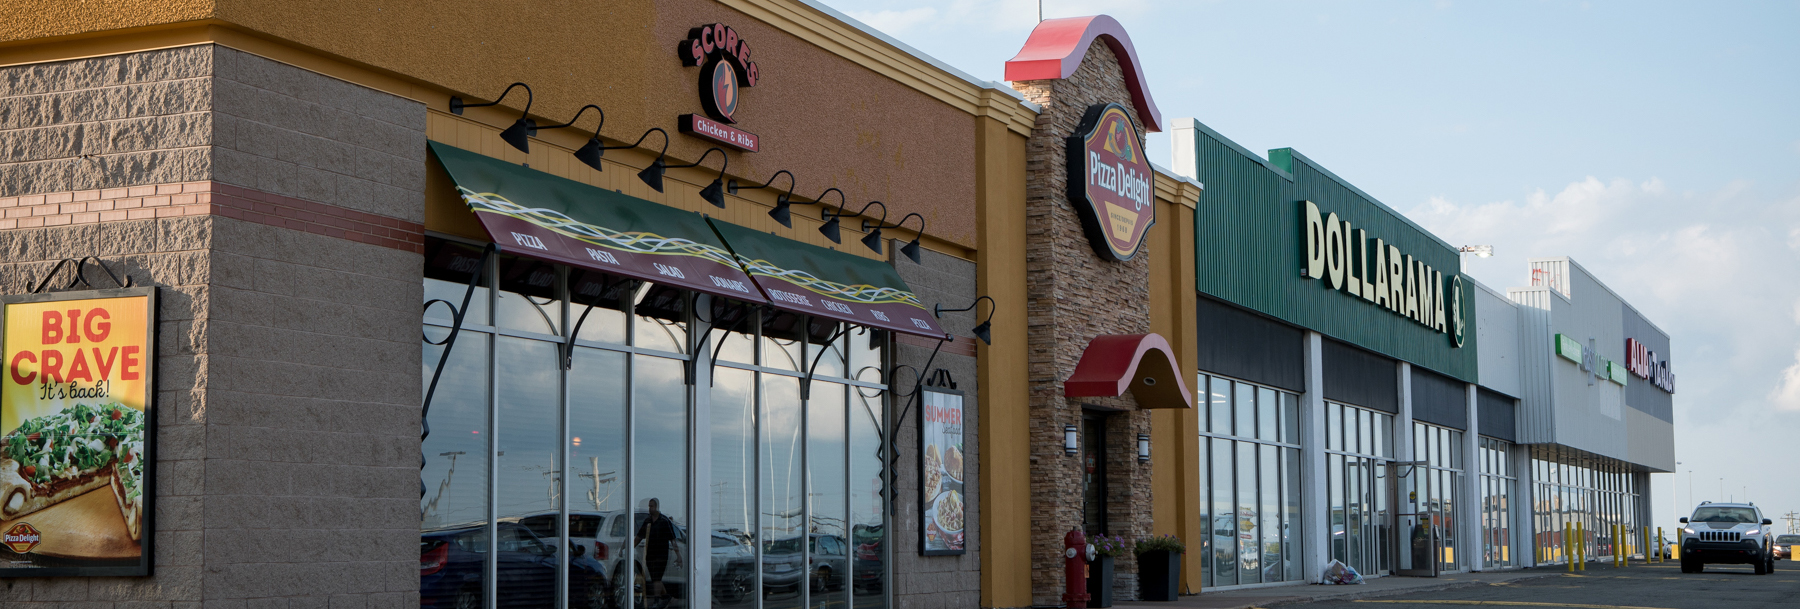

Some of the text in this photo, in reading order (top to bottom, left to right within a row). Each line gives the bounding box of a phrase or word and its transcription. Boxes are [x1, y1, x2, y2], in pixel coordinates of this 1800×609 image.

[692, 23, 759, 87] SCORES
[697, 120, 754, 148] Chicken & Ribs
[1089, 150, 1150, 212] Pizza Delight
[511, 231, 749, 294] PIZZA PASTA SALAD DONAIRS
[1305, 200, 1447, 334] DOLLARAMA
[42, 307, 111, 345] BIG
[767, 287, 933, 331] ROTISSERIE CHICKEN RIBS PIZZA
[10, 345, 139, 385] CRAVE
[40, 379, 110, 400] It's back!
[925, 404, 961, 425] SUMMER
[5, 534, 39, 544] Pizza Delight
